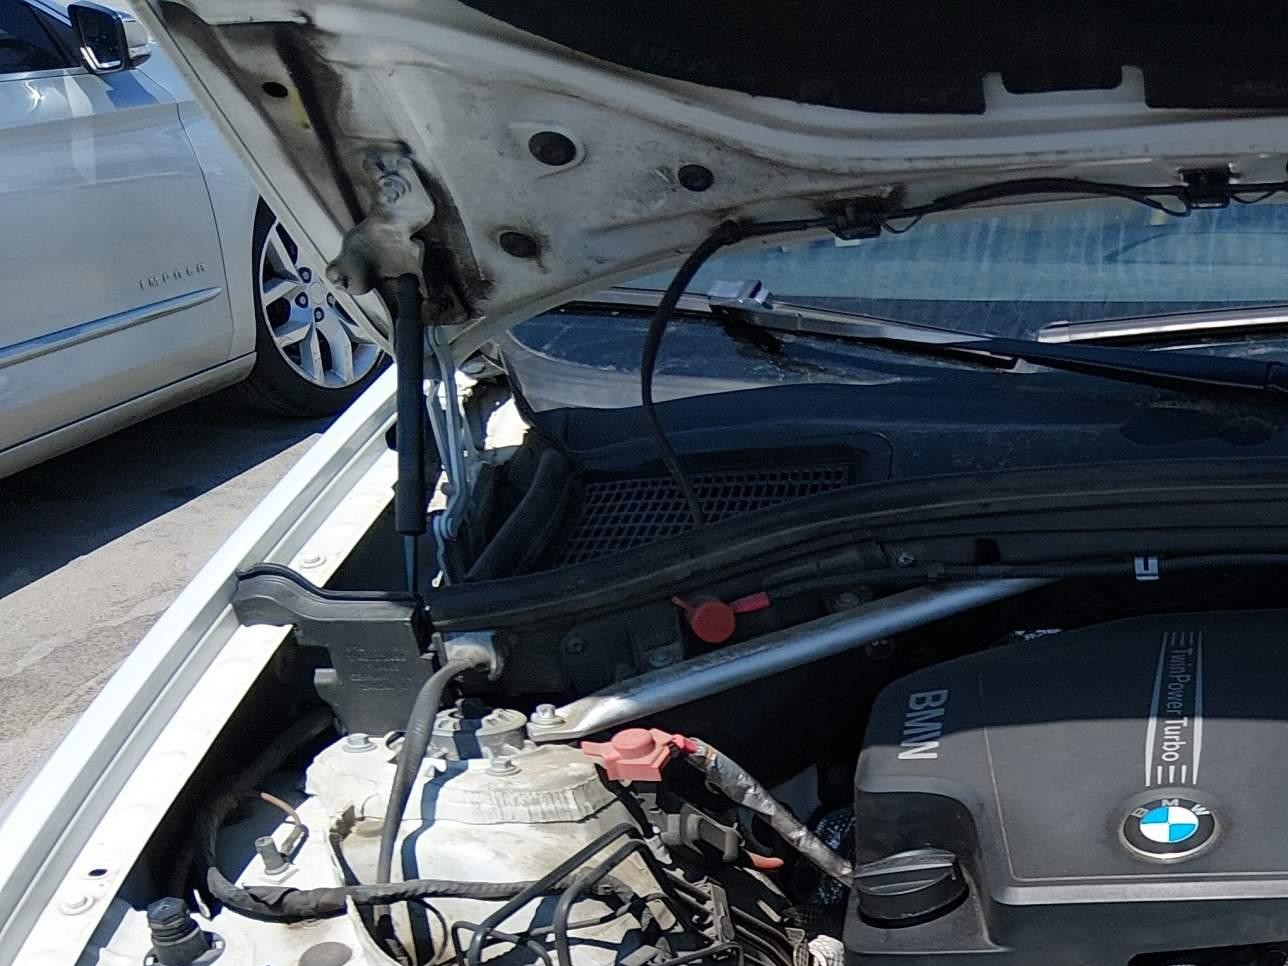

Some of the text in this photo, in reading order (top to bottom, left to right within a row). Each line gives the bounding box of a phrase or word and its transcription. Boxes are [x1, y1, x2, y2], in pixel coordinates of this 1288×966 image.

[138, 262, 205, 290] IMPALA
[898, 689, 949, 760] BMW
[1161, 647, 1193, 763] TwinPower Turbo
[1131, 798, 1211, 819] BMW
